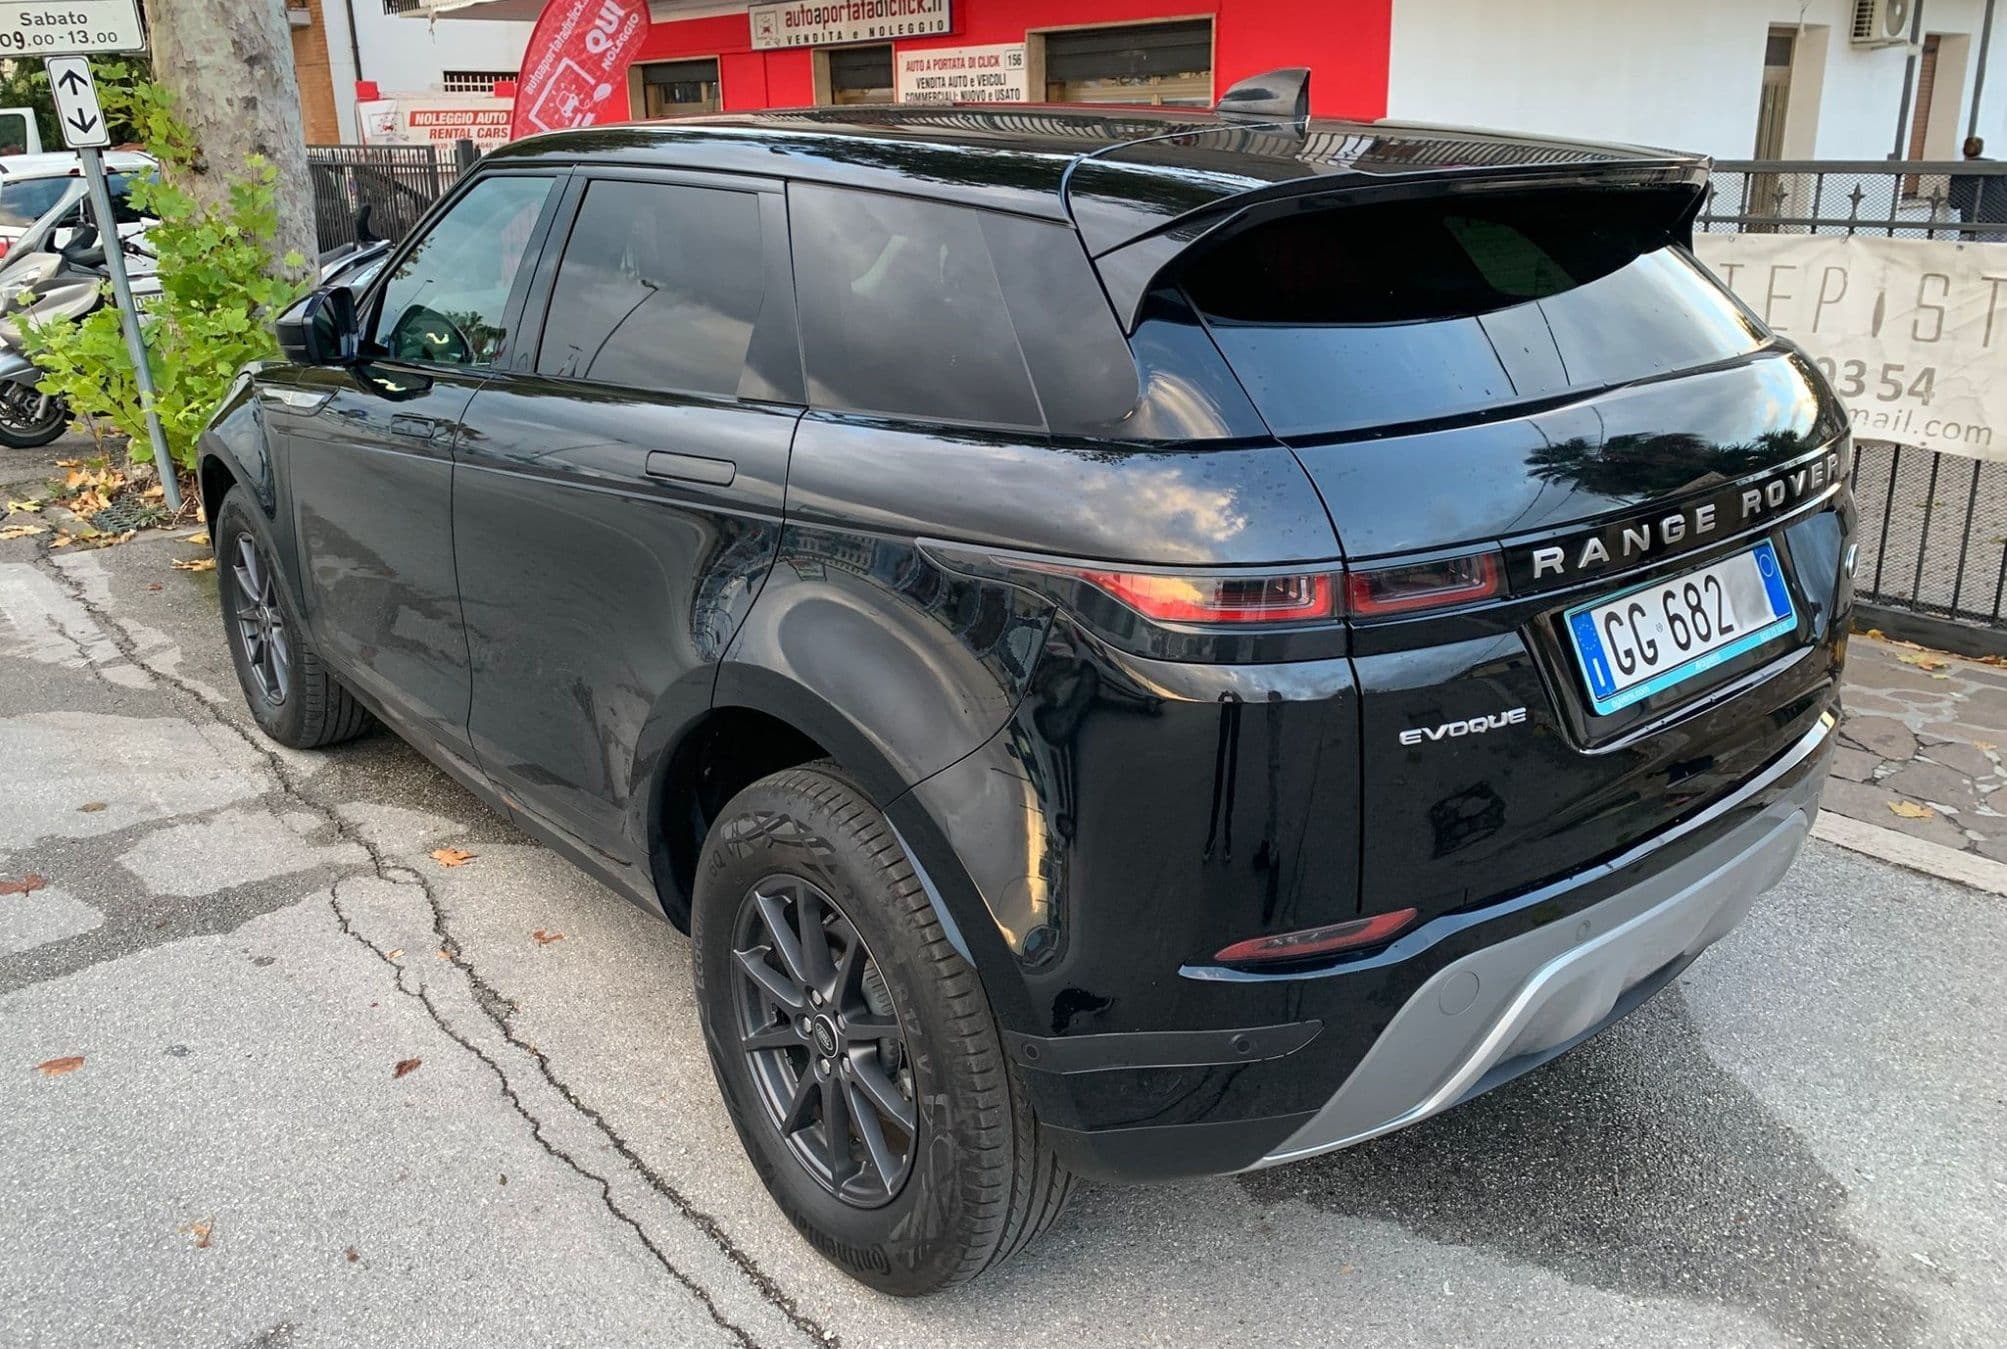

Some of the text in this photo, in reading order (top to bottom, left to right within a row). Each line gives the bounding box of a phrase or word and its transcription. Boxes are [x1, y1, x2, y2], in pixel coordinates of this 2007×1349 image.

[20, 11, 88, 26] Sabato
[585, 0, 625, 54] QUI
[601, 13, 639, 71] NOLEGGIO
[787, 19, 944, 45] VENDITA e NOLEGGIO
[906, 55, 1000, 72] AUTO A PORTATA DI CLICK
[916, 76, 946, 89] VENDITA
[948, 75, 968, 88] AUTO
[976, 73, 1006, 87] VEICOLI
[960, 89, 985, 102] NUOVO
[995, 87, 1020, 101] USATO
[415, 112, 507, 125] NOLEGGIO AUTO
[429, 127, 508, 139] RENTAL CARS
[1532, 453, 1839, 580] RANGE ROVER
[1604, 602, 1660, 676] GG
[1662, 574, 1735, 651] 682
[1399, 706, 1527, 746] EVOQUE
